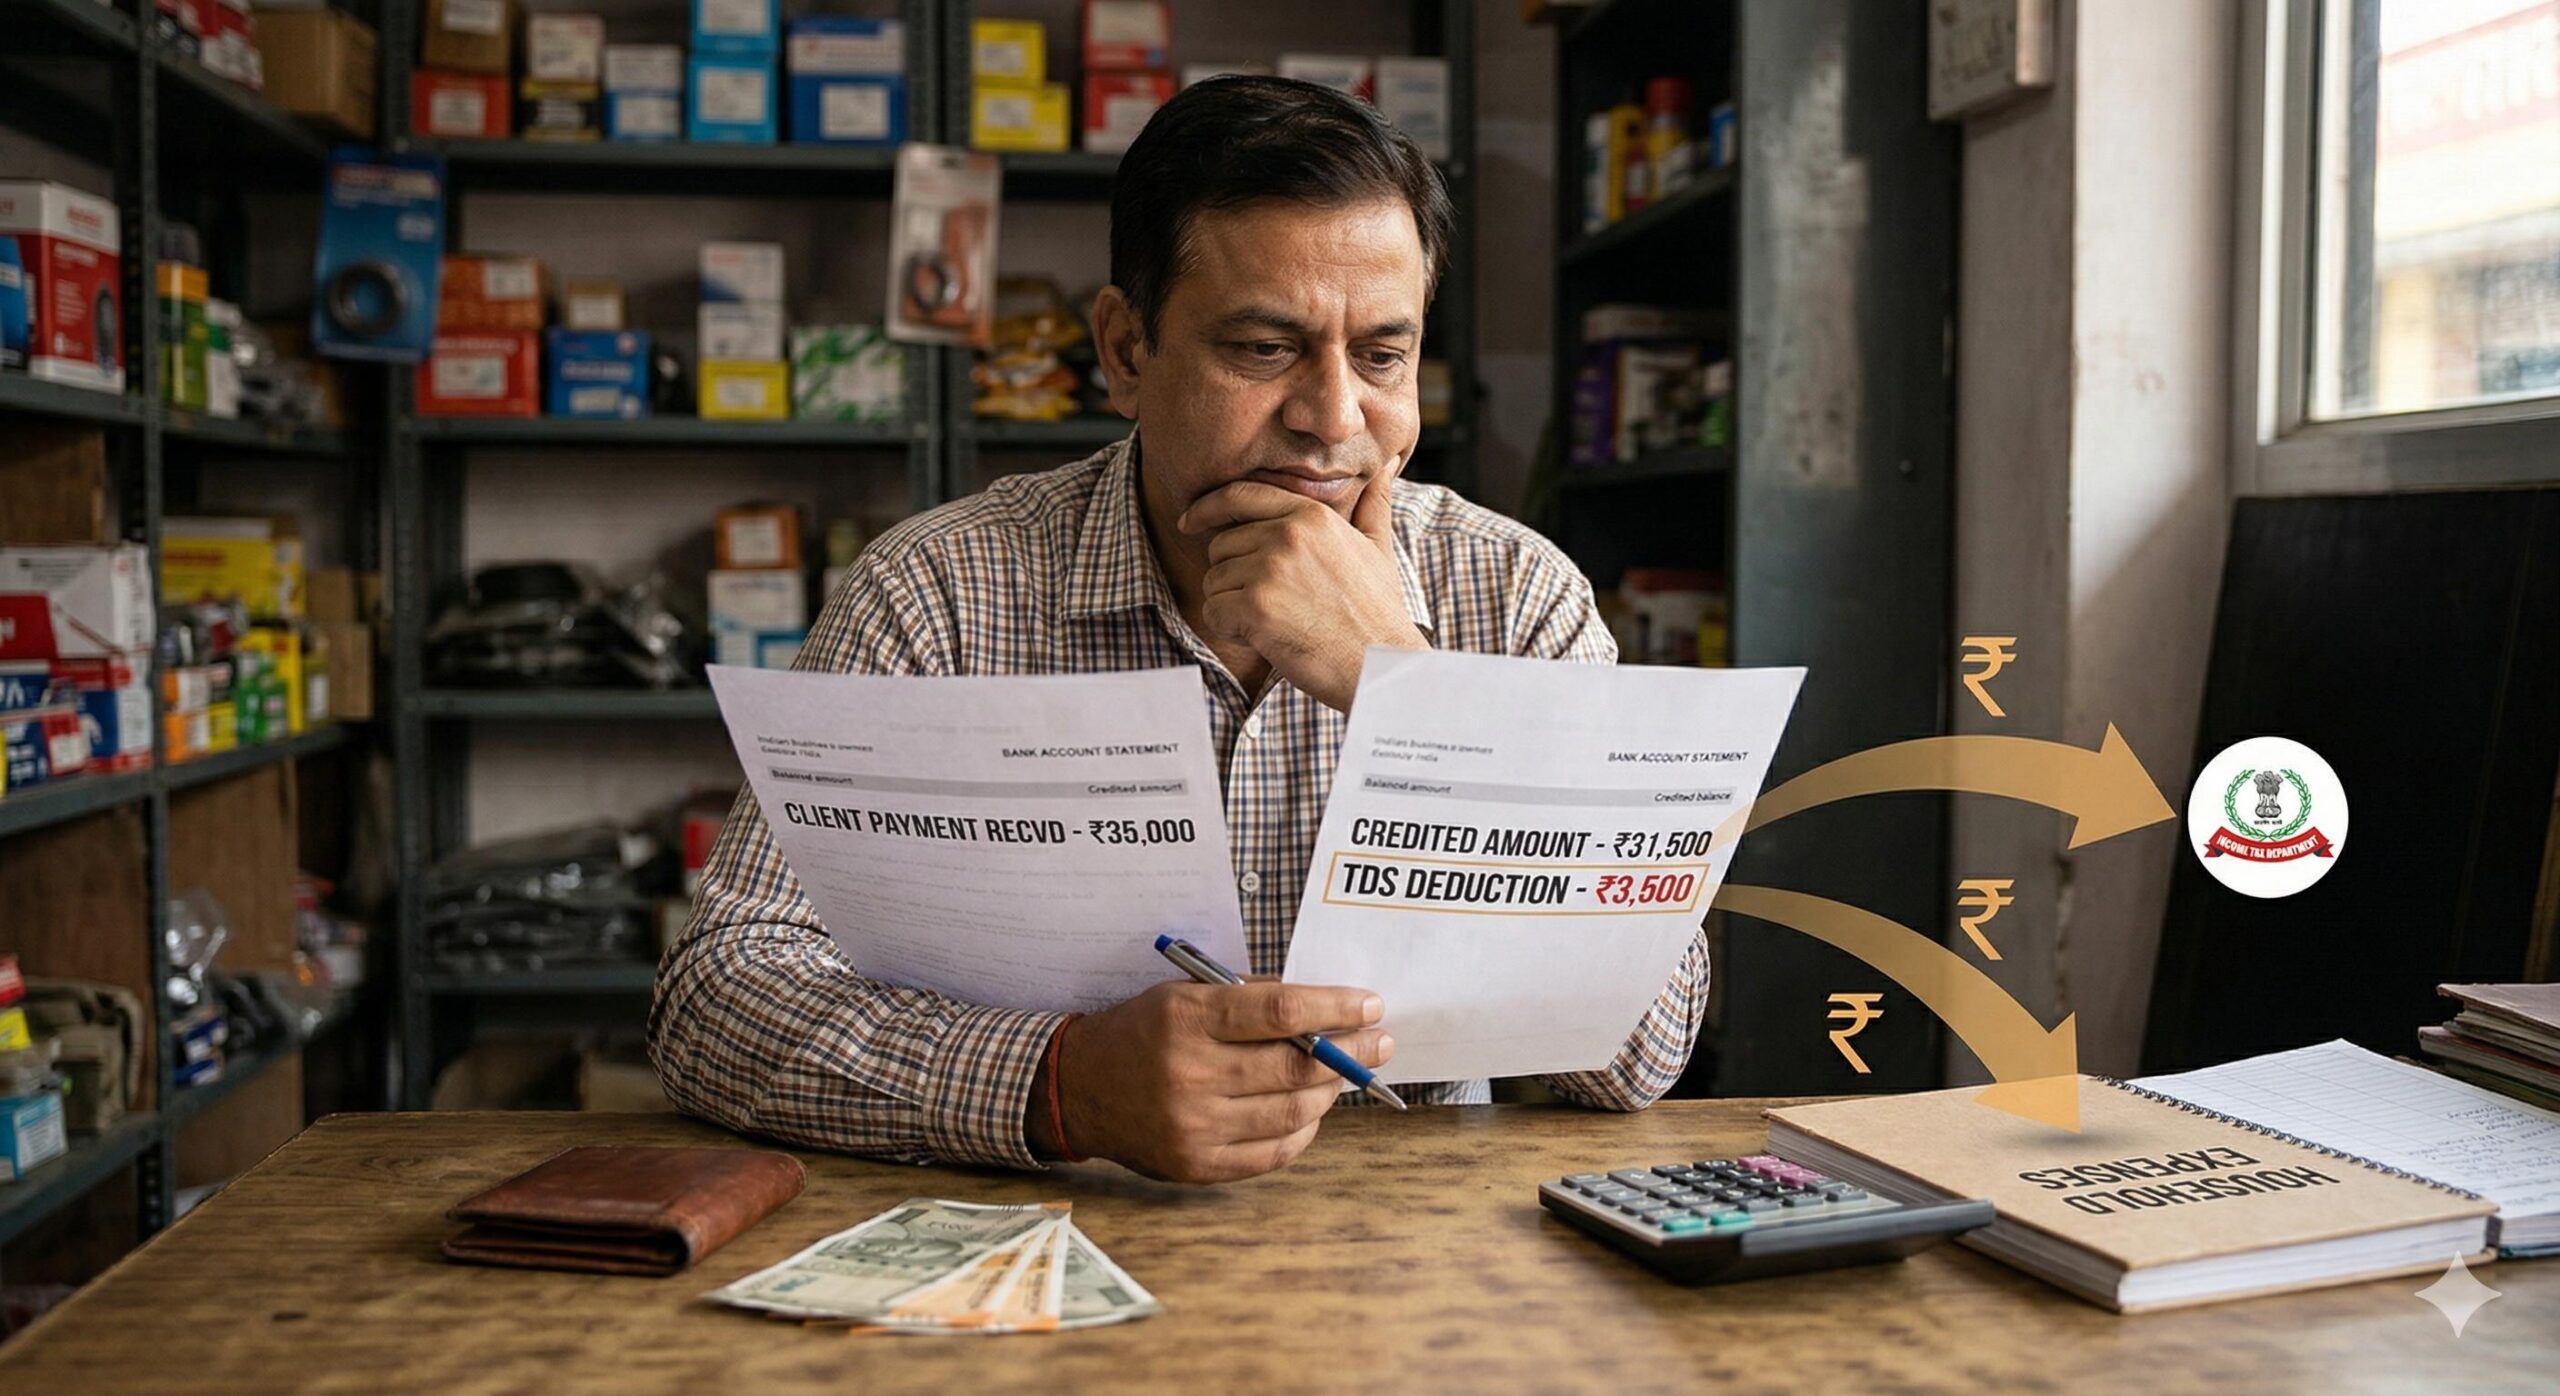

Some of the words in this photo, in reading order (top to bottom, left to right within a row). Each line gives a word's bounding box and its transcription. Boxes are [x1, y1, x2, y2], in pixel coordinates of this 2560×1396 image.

[1002, 747, 1037, 758] BANK
[1040, 746, 1101, 758] ACCOUNT
[1105, 743, 1180, 756] STATEMENT
[1608, 752, 1637, 762] BANK
[1639, 752, 1689, 763] ACCOUNT
[1691, 751, 1749, 763] STATEMENT
[1088, 784, 1137, 794] Credited
[1654, 793, 1695, 802] Credited
[785, 802, 862, 831] CLIENT
[869, 811, 978, 841] PAYMENT
[988, 819, 1066, 844] RECVD
[1089, 818, 1196, 846] ₹35,000
[1351, 818, 1478, 854] CREDITED
[1481, 828, 1591, 858] AMOUNT
[1613, 830, 1713, 861] ₹31,500
[1343, 863, 1398, 897] TDS
[1405, 868, 1570, 904] DEDUCTION
[1595, 873, 1695, 907] ₹3,500
[2018, 1147, 2261, 1190] EXPENSES
[2062, 1166, 2341, 1215] HOUSEHOLD
